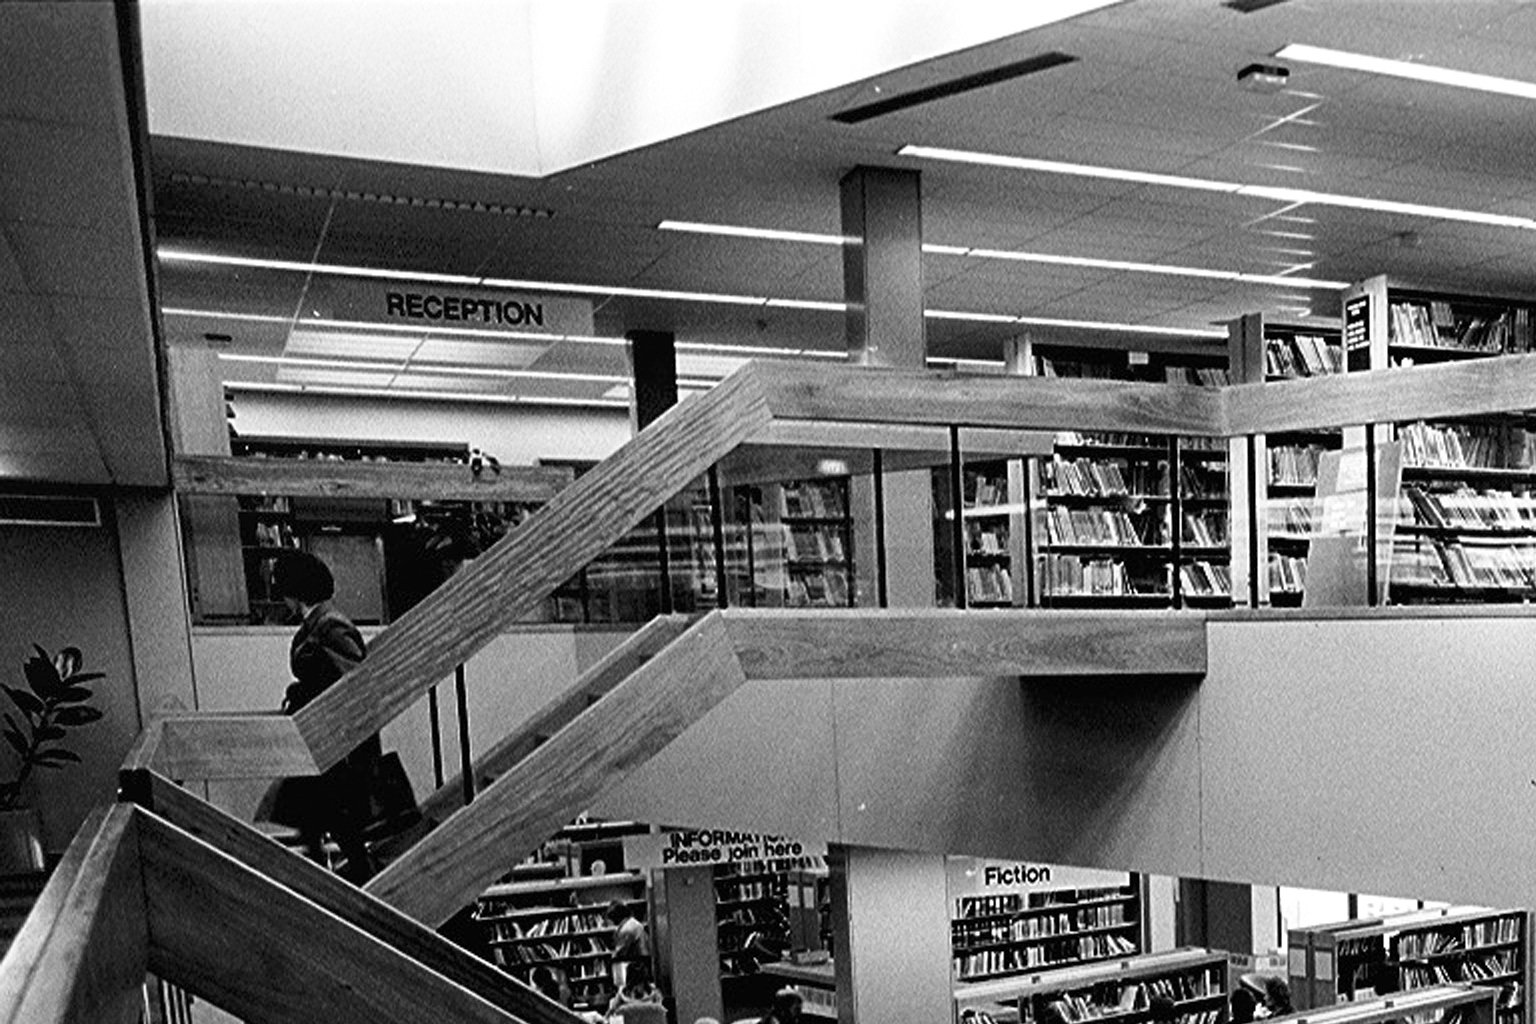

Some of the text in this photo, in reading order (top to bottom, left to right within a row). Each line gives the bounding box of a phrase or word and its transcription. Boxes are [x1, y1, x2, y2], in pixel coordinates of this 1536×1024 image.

[386, 292, 543, 326] RECEPTION
[663, 841, 803, 864] Please join here
[985, 865, 1050, 885] Fiction
